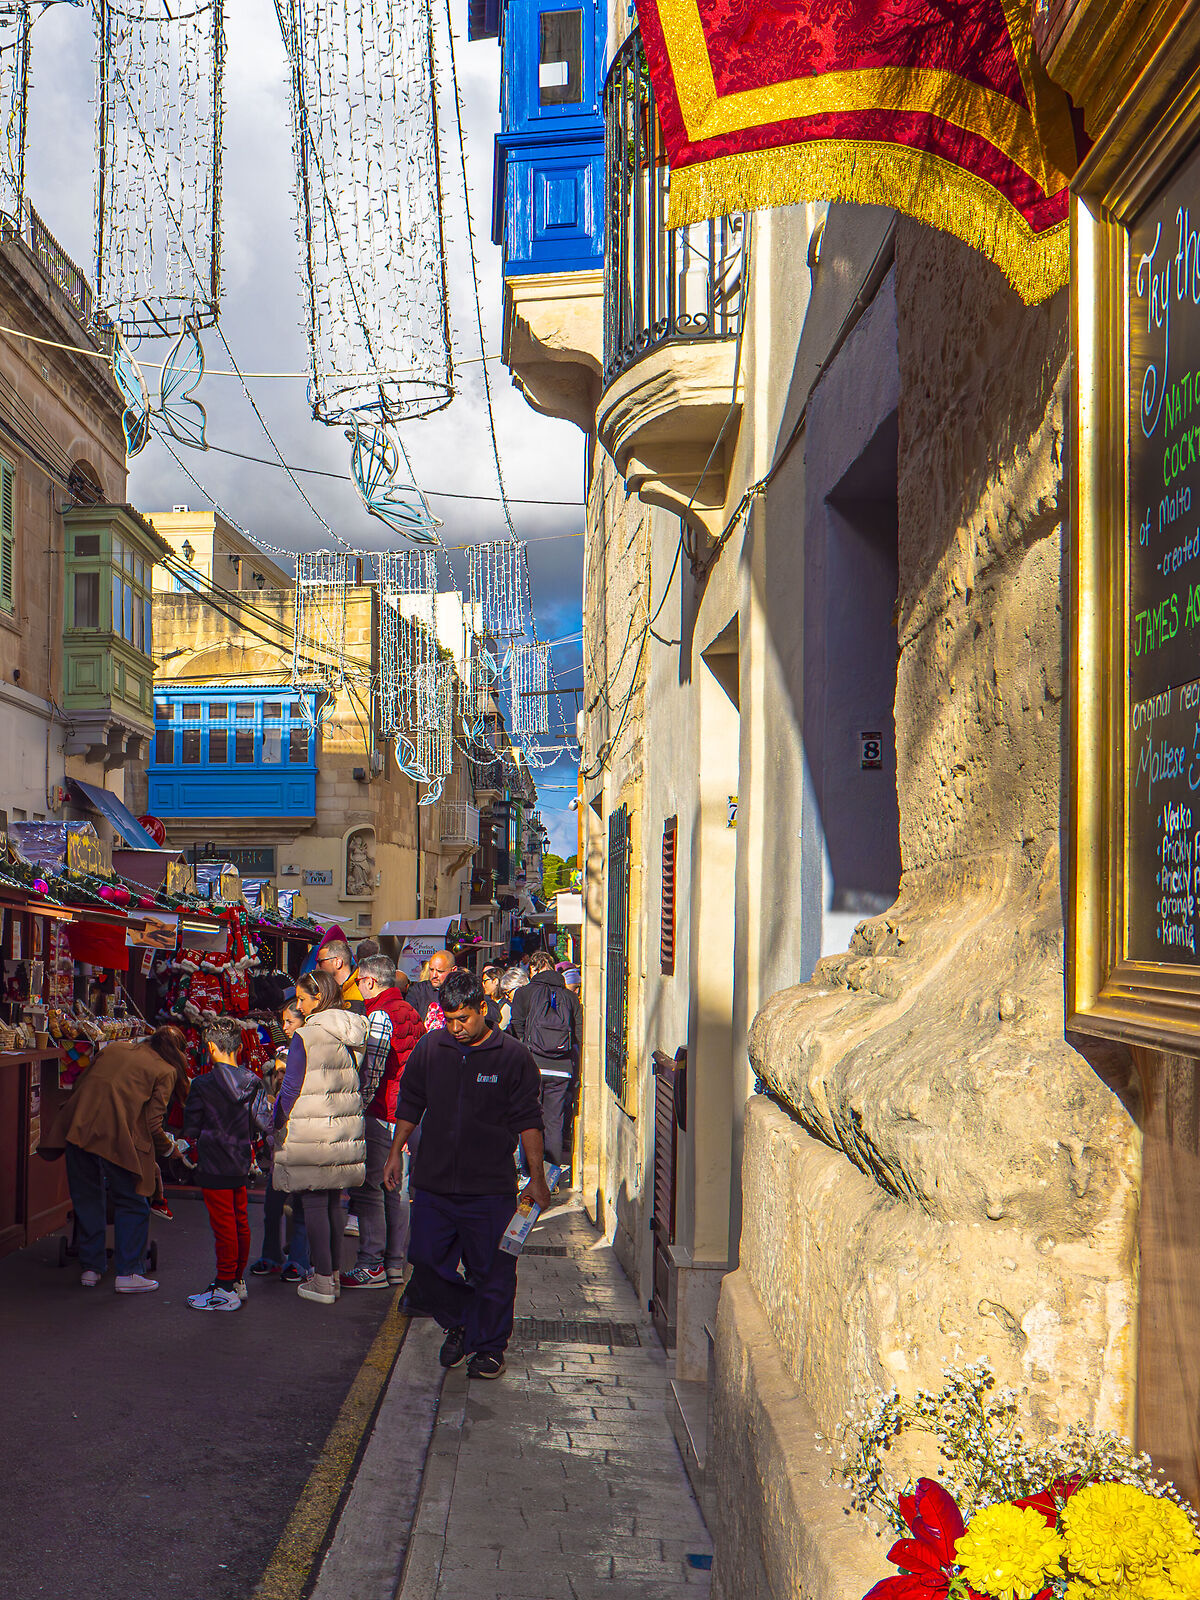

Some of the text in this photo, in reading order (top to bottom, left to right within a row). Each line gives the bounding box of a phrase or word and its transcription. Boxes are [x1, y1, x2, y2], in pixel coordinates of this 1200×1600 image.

[1139, 487, 1192, 547] of Malta
[1134, 593, 1179, 656] JAMES
[1133, 685, 1171, 741] original
[864, 741, 880, 760] 8
[1135, 739, 1186, 804] Maltese
[729, 804, 738, 821] 7
